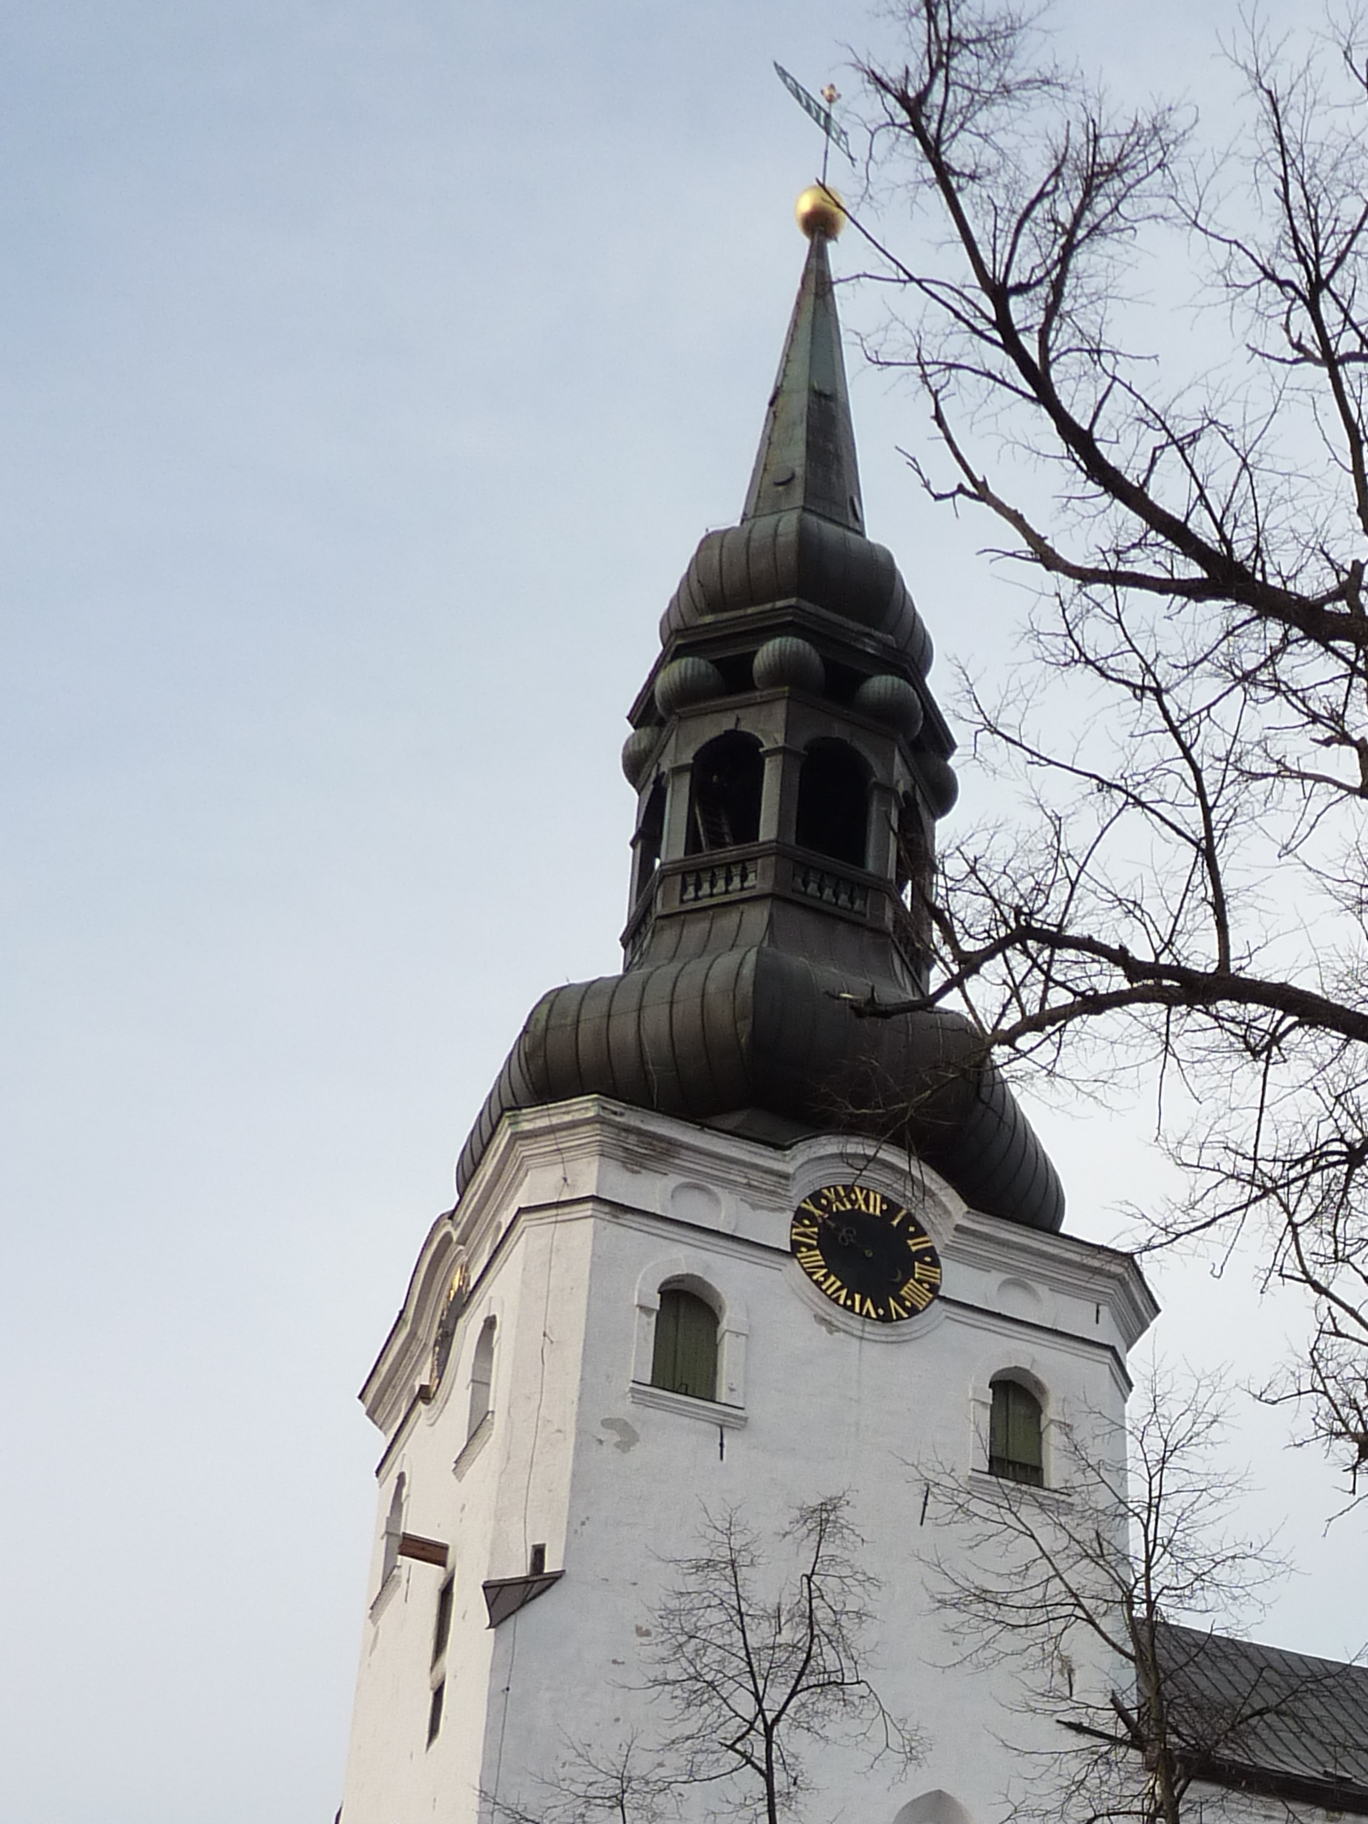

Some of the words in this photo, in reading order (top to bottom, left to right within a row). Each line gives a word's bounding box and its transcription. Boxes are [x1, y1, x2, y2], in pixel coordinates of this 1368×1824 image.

[800, 1198, 825, 1217] X
[854, 1186, 882, 1217] XII
[890, 1208, 907, 1227] I
[791, 1220, 818, 1246] IX
[907, 1236, 933, 1252] II
[796, 1249, 828, 1280] VIII
[914, 1261, 942, 1284] III
[821, 1274, 847, 1305] VII
[899, 1279, 934, 1311] IIII
[854, 1293, 878, 1318] VI
[889, 1296, 909, 1320] V
